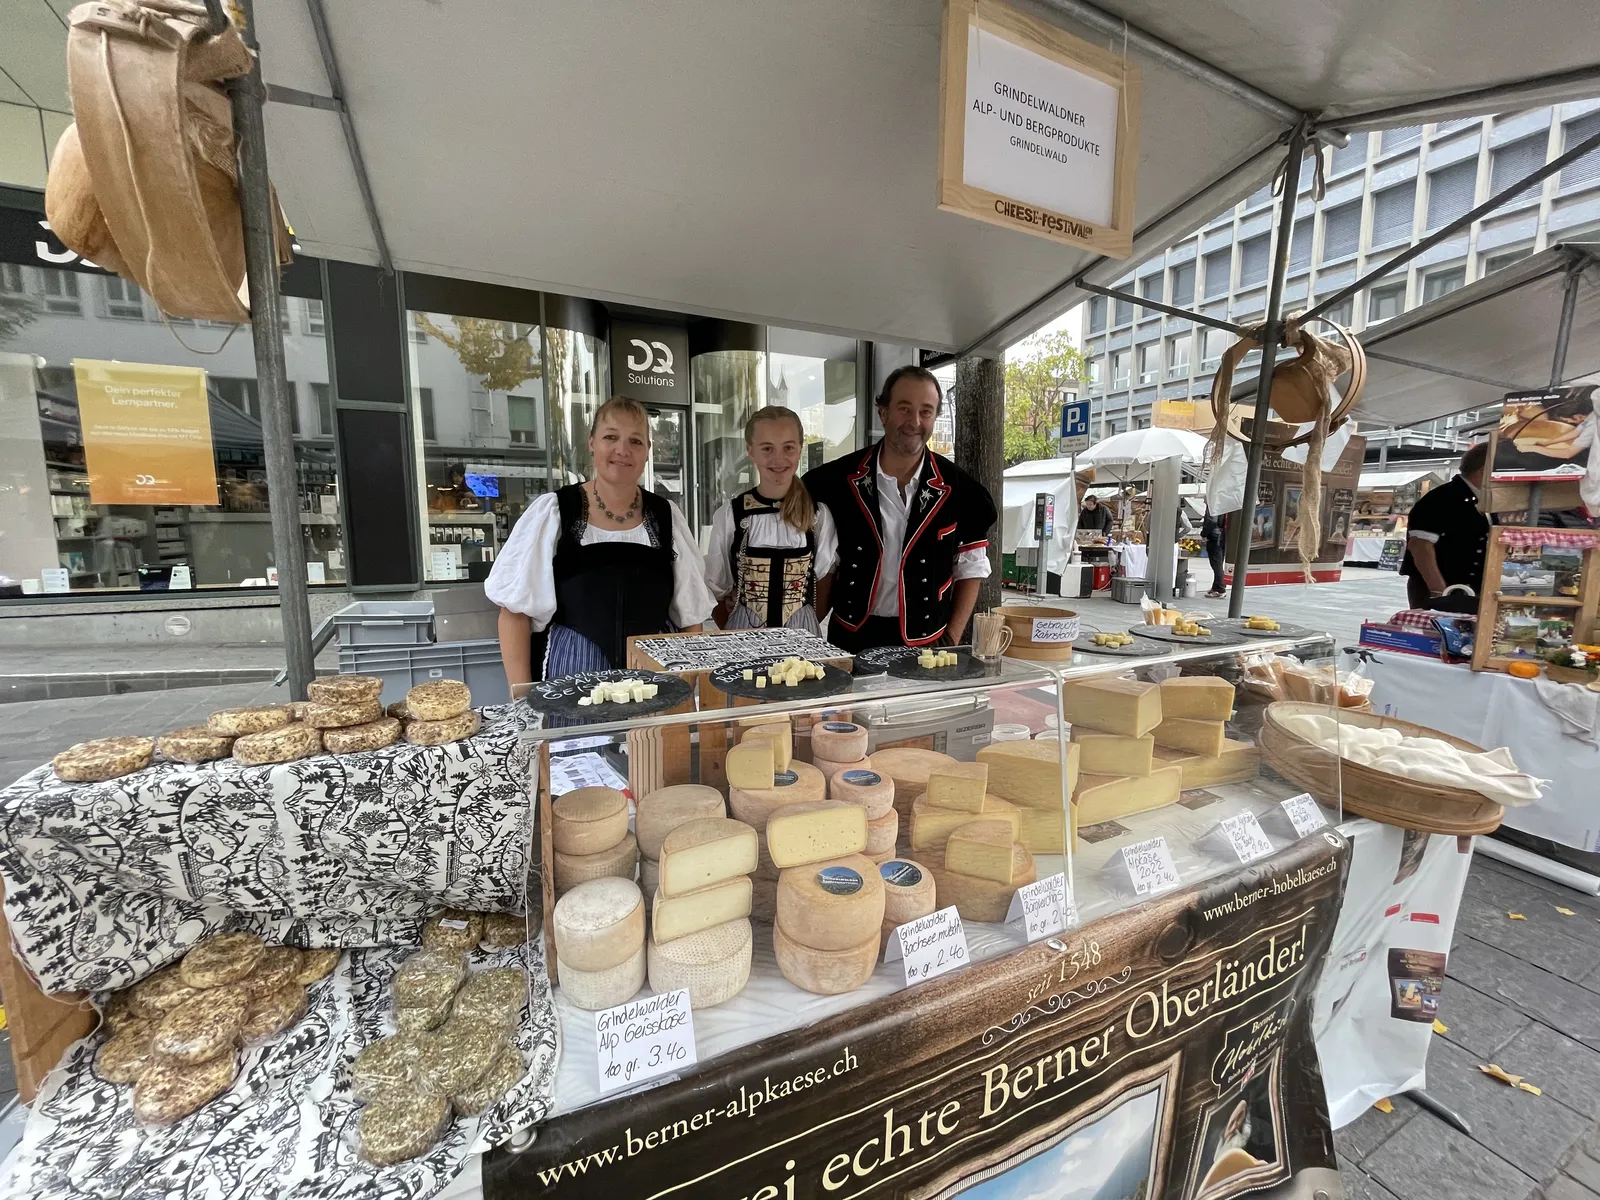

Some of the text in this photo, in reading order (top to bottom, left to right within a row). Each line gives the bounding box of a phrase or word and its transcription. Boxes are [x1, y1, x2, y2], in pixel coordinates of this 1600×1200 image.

[993, 81, 1086, 128] GRINDELWALDNER
[972, 99, 1101, 157] ALP- UND BERGPRODUKTE
[1009, 135, 1068, 164] GRINDELWALD
[627, 338, 676, 375] DQ
[104, 384, 183, 399] Dein perfekter
[628, 372, 675, 388] Solutions
[111, 397, 179, 409] Lernpartner.
[1066, 406, 1081, 433] P
[1139, 860, 1165, 880] 2022
[1202, 859, 1338, 923] www.berner-hobelkaese.ch
[899, 912, 948, 941] Grindelwalder
[936, 944, 965, 968] 2.40
[1025, 941, 1102, 1004] seit 1548
[597, 990, 687, 1032] Grindelwalder
[598, 1008, 691, 1059] Alp Geisskäse
[604, 1060, 622, 1079] 100
[647, 1041, 687, 1067] 3.40
[821, 1108, 961, 1192] echte
[978, 1024, 1116, 1120] Berner
[1125, 924, 1306, 1040] Oberländer!
[536, 1046, 859, 1187] www.berner-alpkaese.ch
